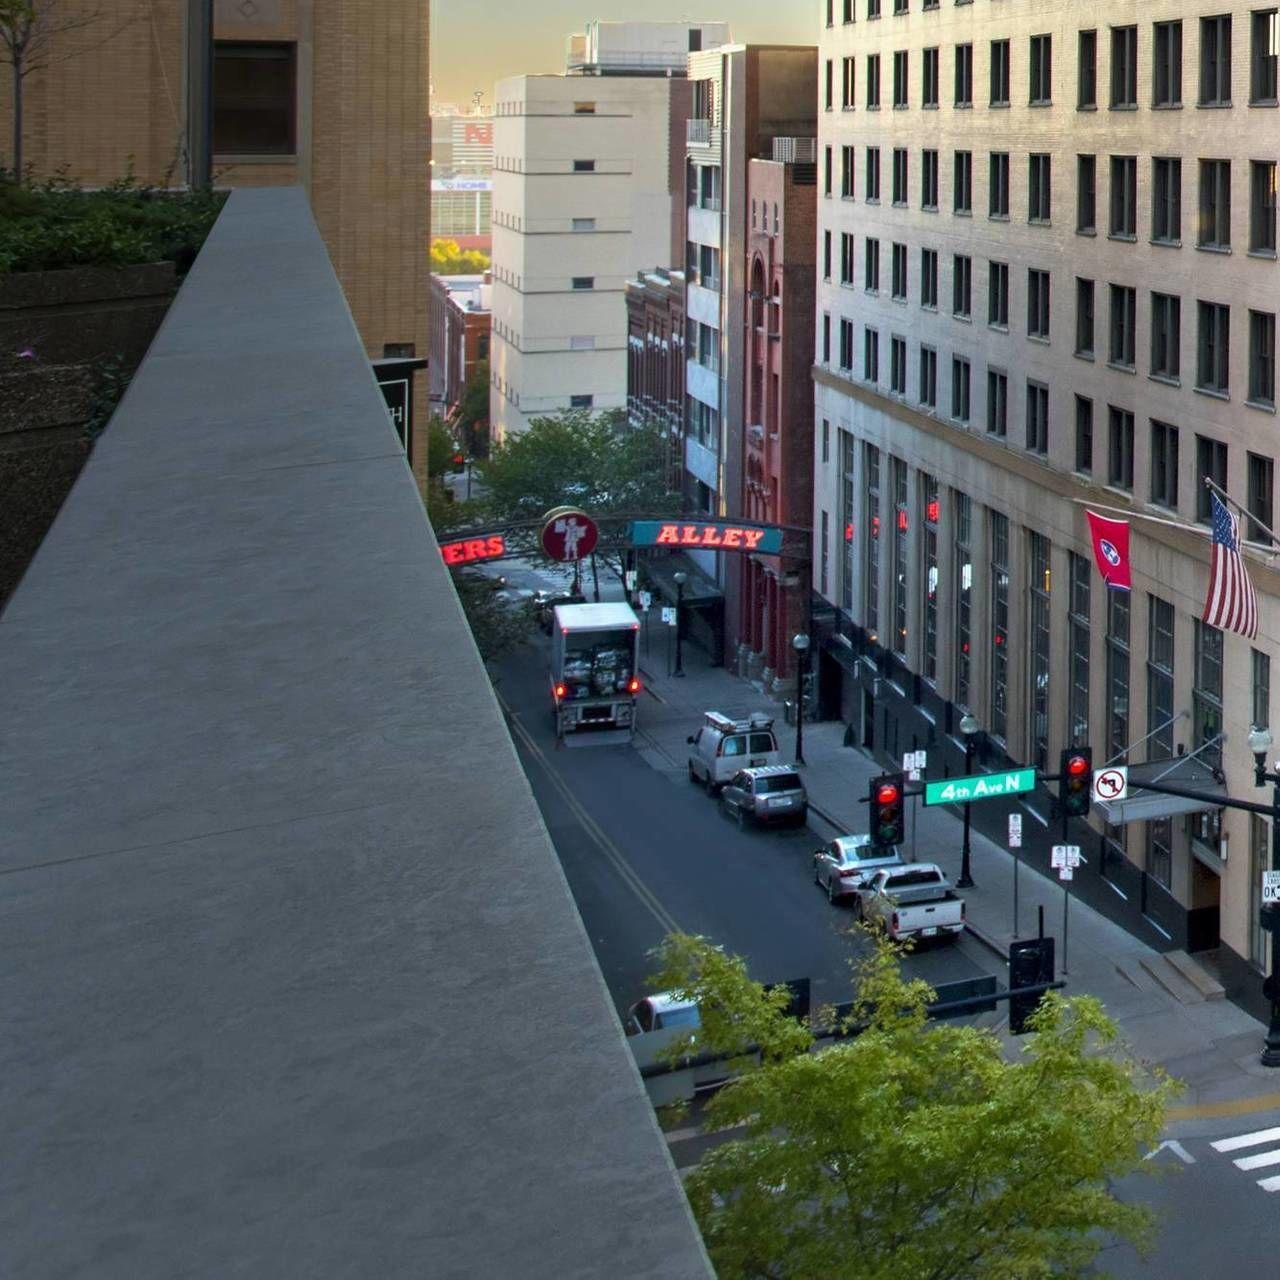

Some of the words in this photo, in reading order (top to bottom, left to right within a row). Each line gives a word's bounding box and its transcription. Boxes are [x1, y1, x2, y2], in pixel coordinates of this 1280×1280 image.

[657, 525, 764, 548] ALLEY
[438, 534, 504, 565] ERS
[941, 784, 969, 799] 4th
[973, 780, 1003, 797] Ave
[1006, 774, 1020, 792] N
[1264, 887, 1276, 897] OK
